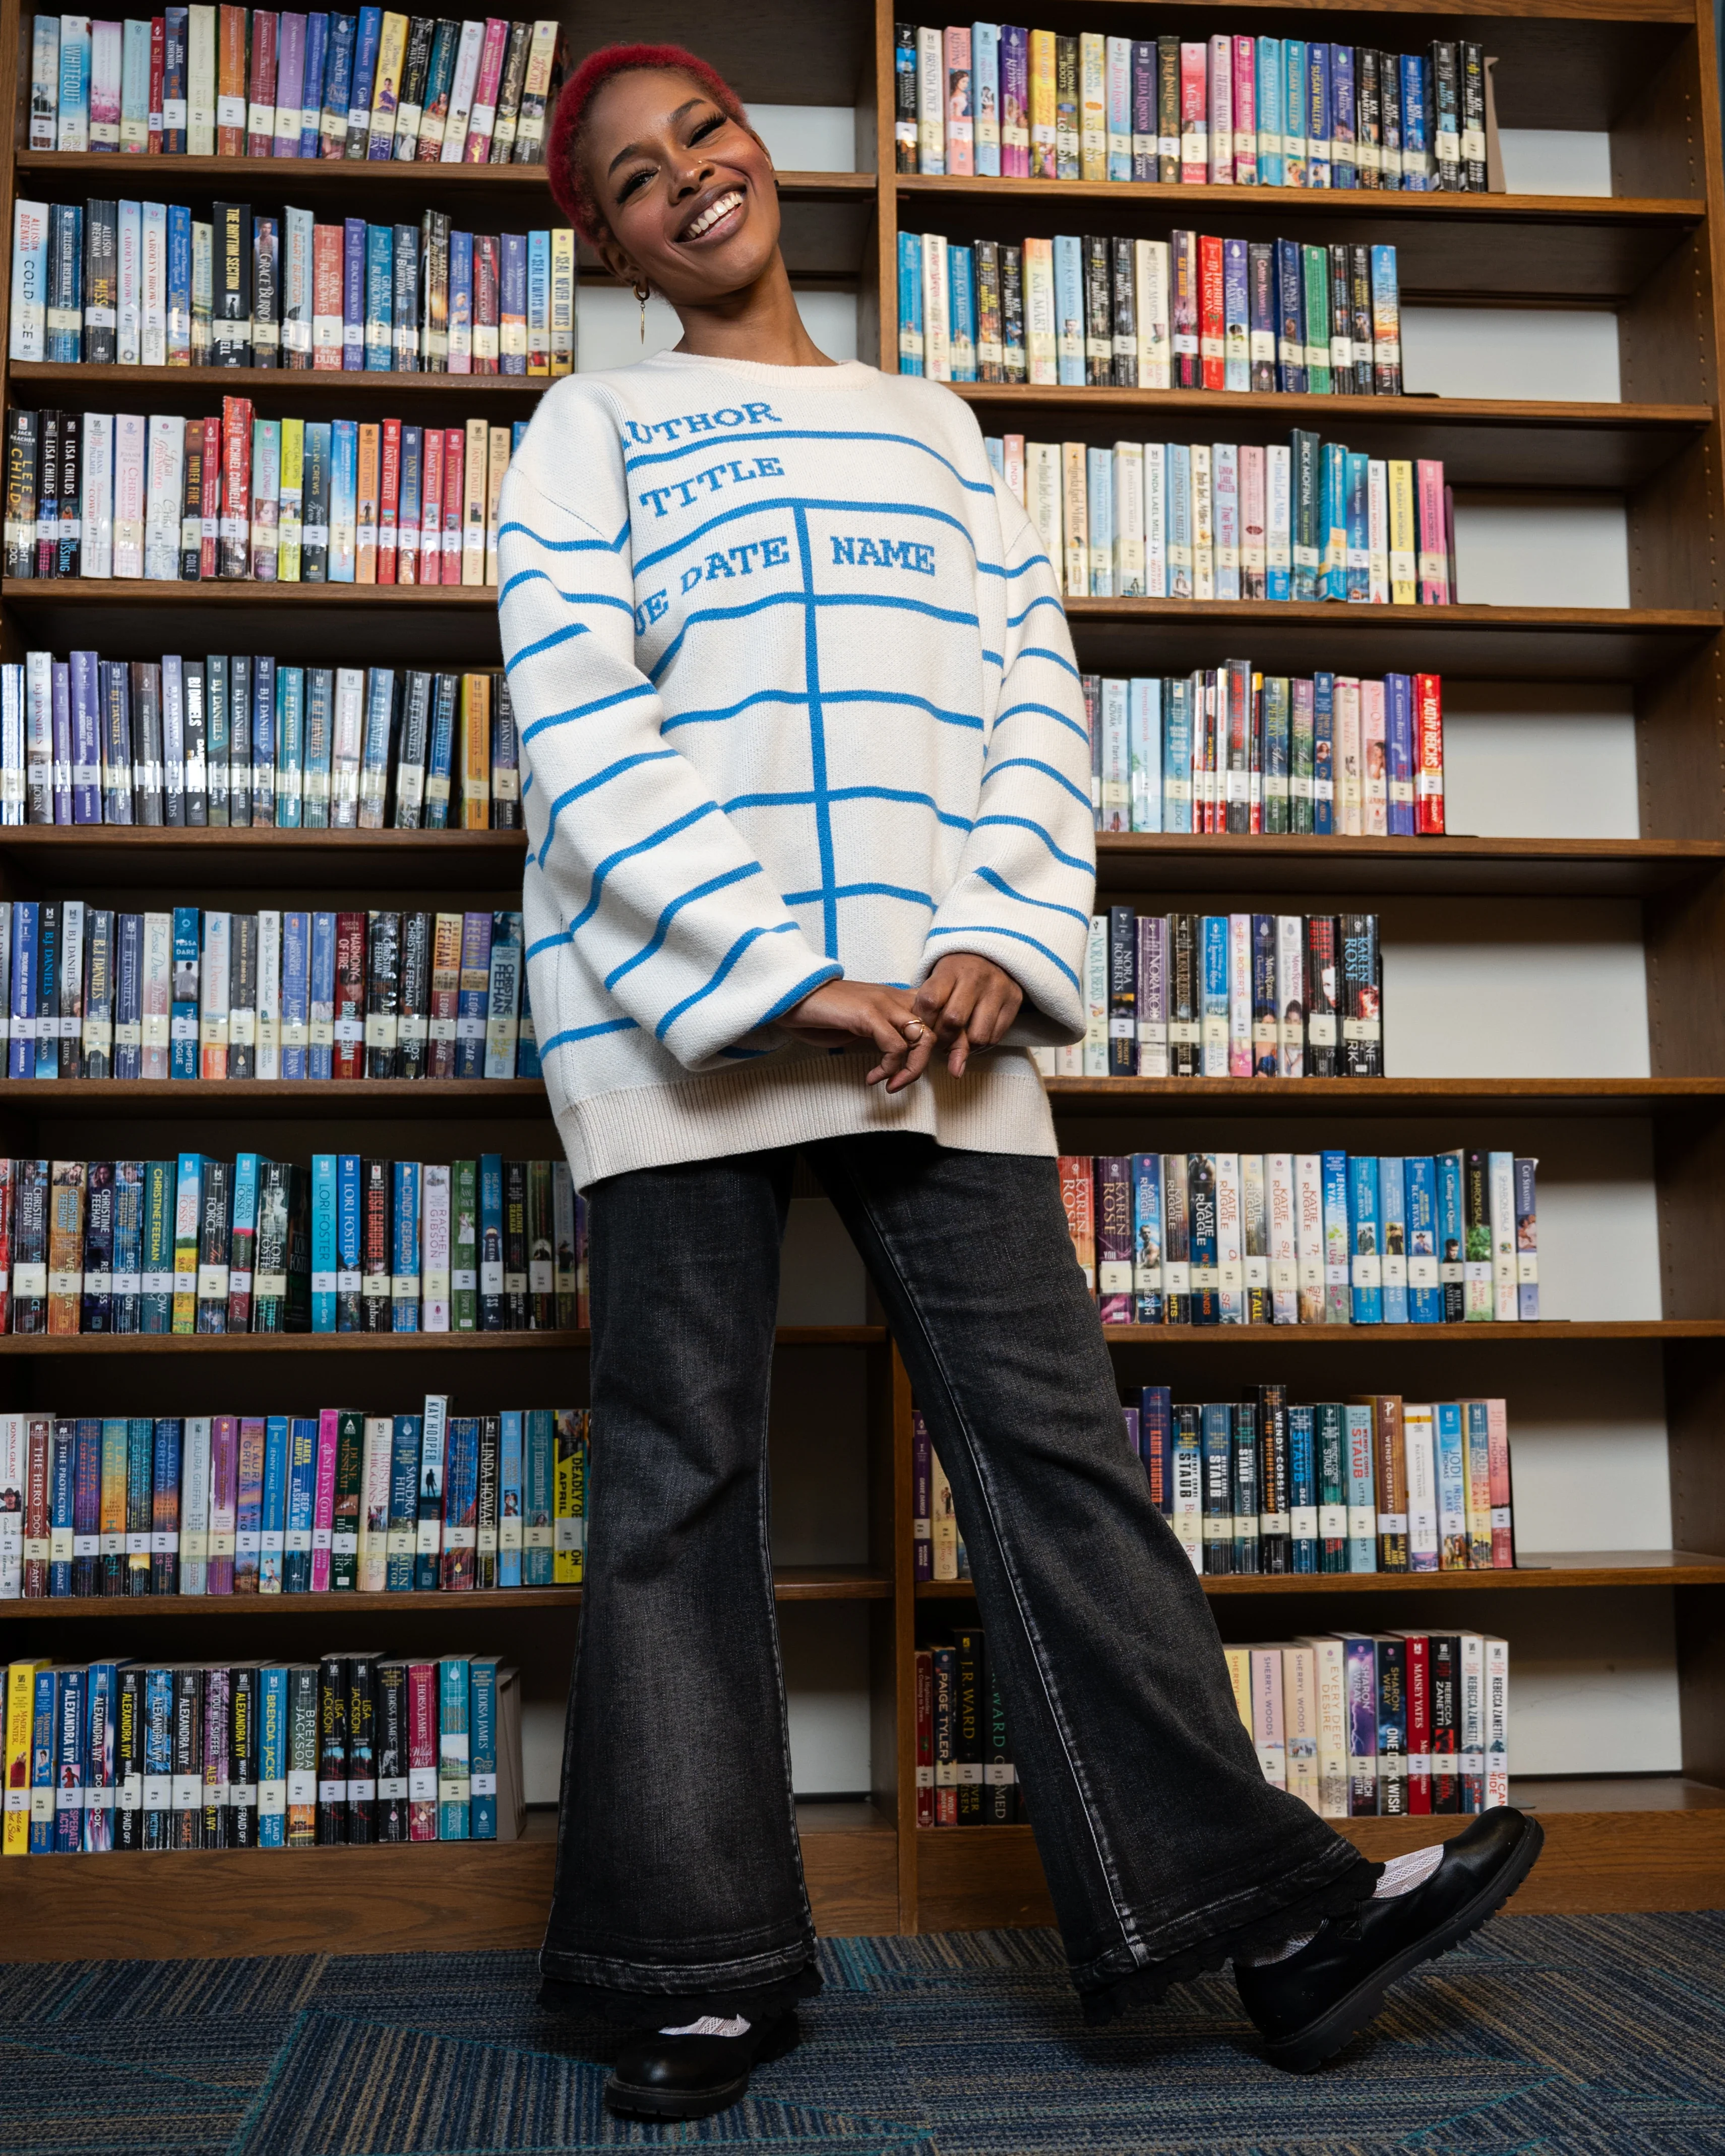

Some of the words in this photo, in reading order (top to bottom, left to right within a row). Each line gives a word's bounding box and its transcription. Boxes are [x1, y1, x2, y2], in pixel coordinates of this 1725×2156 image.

[167, 40, 175, 69] ASHENDEN
[926, 52, 935, 85] BRENDA
[64, 45, 80, 103] WHITEOUT
[1136, 68, 1149, 95] JULIA
[926, 88, 937, 113] JOYCE
[1136, 96, 1149, 130] LONDON
[227, 209, 239, 222] THE
[20, 214, 29, 252] BRENNAN
[31, 219, 39, 251] ALLISON
[226, 224, 239, 256] RHYTHM
[293, 234, 301, 259] MARY
[24, 261, 34, 299] COLD
[226, 258, 239, 289] SECTION
[556, 257, 569, 273] SEAL
[319, 263, 329, 313] BURROWES
[330, 272, 339, 304] GRACE
[556, 278, 569, 300] NEVER
[1205, 272, 1213, 311] MASON
[1214, 273, 1222, 314] DEBBIE
[556, 304, 569, 326] QUITS
[65, 440, 75, 459] LISA
[230, 438, 239, 469] MICHAEL
[384, 446, 393, 470] JANET
[1302, 442, 1310, 464] RICK
[10, 448, 21, 503] CHILD
[22, 461, 32, 493] LEE
[65, 463, 75, 495] CHILDS
[189, 456, 200, 483] UNDER
[383, 473, 393, 500] DAILEY
[1302, 466, 1310, 505] MOFINA
[188, 487, 199, 504] FIRE
[229, 472, 240, 508] CONNELLY
[639, 457, 785, 517] TITLE
[187, 555, 196, 572] COLE
[830, 535, 936, 577] NAME
[635, 588, 668, 637] UE
[681, 536, 790, 595] DATE
[35, 700, 44, 744] DANIELS
[1424, 698, 1436, 728] KATHY
[1425, 731, 1437, 766] REICHS
[151, 926, 165, 953] Tessa
[211, 940, 223, 965] Jude
[339, 939, 349, 951] OF
[350, 934, 361, 976] HARMONY
[44, 949, 53, 995] DANIELS
[151, 956, 165, 981] Dare
[338, 953, 349, 969] FIRE
[1114, 943, 1123, 991] ROBERTS
[1124, 951, 1132, 983] NORA
[1345, 938, 1358, 980] ROSE
[1359, 937, 1368, 981] KAREN
[210, 970, 223, 1008] Deveraux
[494, 964, 505, 1014] FEEHAN
[504, 964, 514, 1014] CHRISTINE
[153, 1169, 162, 1219] CHRISTINE
[345, 1184, 354, 1211] LORI
[369, 1191, 384, 1210] LISA
[401, 1186, 412, 1217] CINDY
[1327, 1183, 1335, 1210] RYAN
[1336, 1173, 1344, 1220] JENNIFER
[179, 1195, 188, 1233] FOSSEN
[188, 1195, 196, 1232] DELORES
[1196, 1193, 1205, 1246] RUGGLE
[1204, 1202, 1213, 1237] KATIE
[152, 1222, 160, 1261] FEEHAN
[345, 1216, 354, 1259] FOSTER
[368, 1214, 383, 1258] GARDNER
[401, 1221, 413, 1264] GERARD
[430, 1210, 438, 1258] GIBSON
[439, 1210, 447, 1257] RACHEL
[427, 1402, 440, 1420] KAY
[294, 1437, 302, 1465] HARPER
[303, 1439, 311, 1463] KAREN
[425, 1424, 438, 1460] HOOPER
[1150, 1430, 1161, 1454] KARIN
[157, 1440, 166, 1491] GRIFFIN
[167, 1445, 175, 1487] LAURA
[571, 1457, 583, 1500] DEADLY
[1179, 1453, 1192, 1497] STAUB
[1450, 1449, 1460, 1477] JODI
[58, 1467, 67, 1523] PROTECTOR
[395, 1477, 405, 1504] HILL
[405, 1466, 415, 1514] SANDRA
[1150, 1458, 1162, 1503] SLAUGHTER
[939, 1673, 948, 1711] PAIGE
[1264, 1657, 1272, 1696] SHERRYL
[1331, 1667, 1339, 1709] EVERY
[1413, 1664, 1423, 1698] MAISEY
[1492, 1677, 1503, 1707] REBECCA
[65, 1690, 75, 1744] ALEXANDRA
[324, 1686, 332, 1733] JACKSON
[335, 1700, 343, 1718] LISA
[478, 1689, 487, 1717] ELOISA
[963, 1689, 974, 1738] WARD
[1322, 1684, 1331, 1732] DESIRE
[1414, 1700, 1424, 1728] YATES
[211, 1727, 219, 1755] SUFFER
[295, 1706, 304, 1771] JACKSON
[305, 1710, 315, 1768] BRENDA
[477, 1720, 487, 1748] JAMES
[940, 1716, 948, 1758] TYLER
[1386, 1728, 1398, 1749] ONE
[1493, 1710, 1504, 1739] ZANETTI
[63, 1748, 73, 1762] IVY
[1388, 1784, 1400, 1812] WISH
